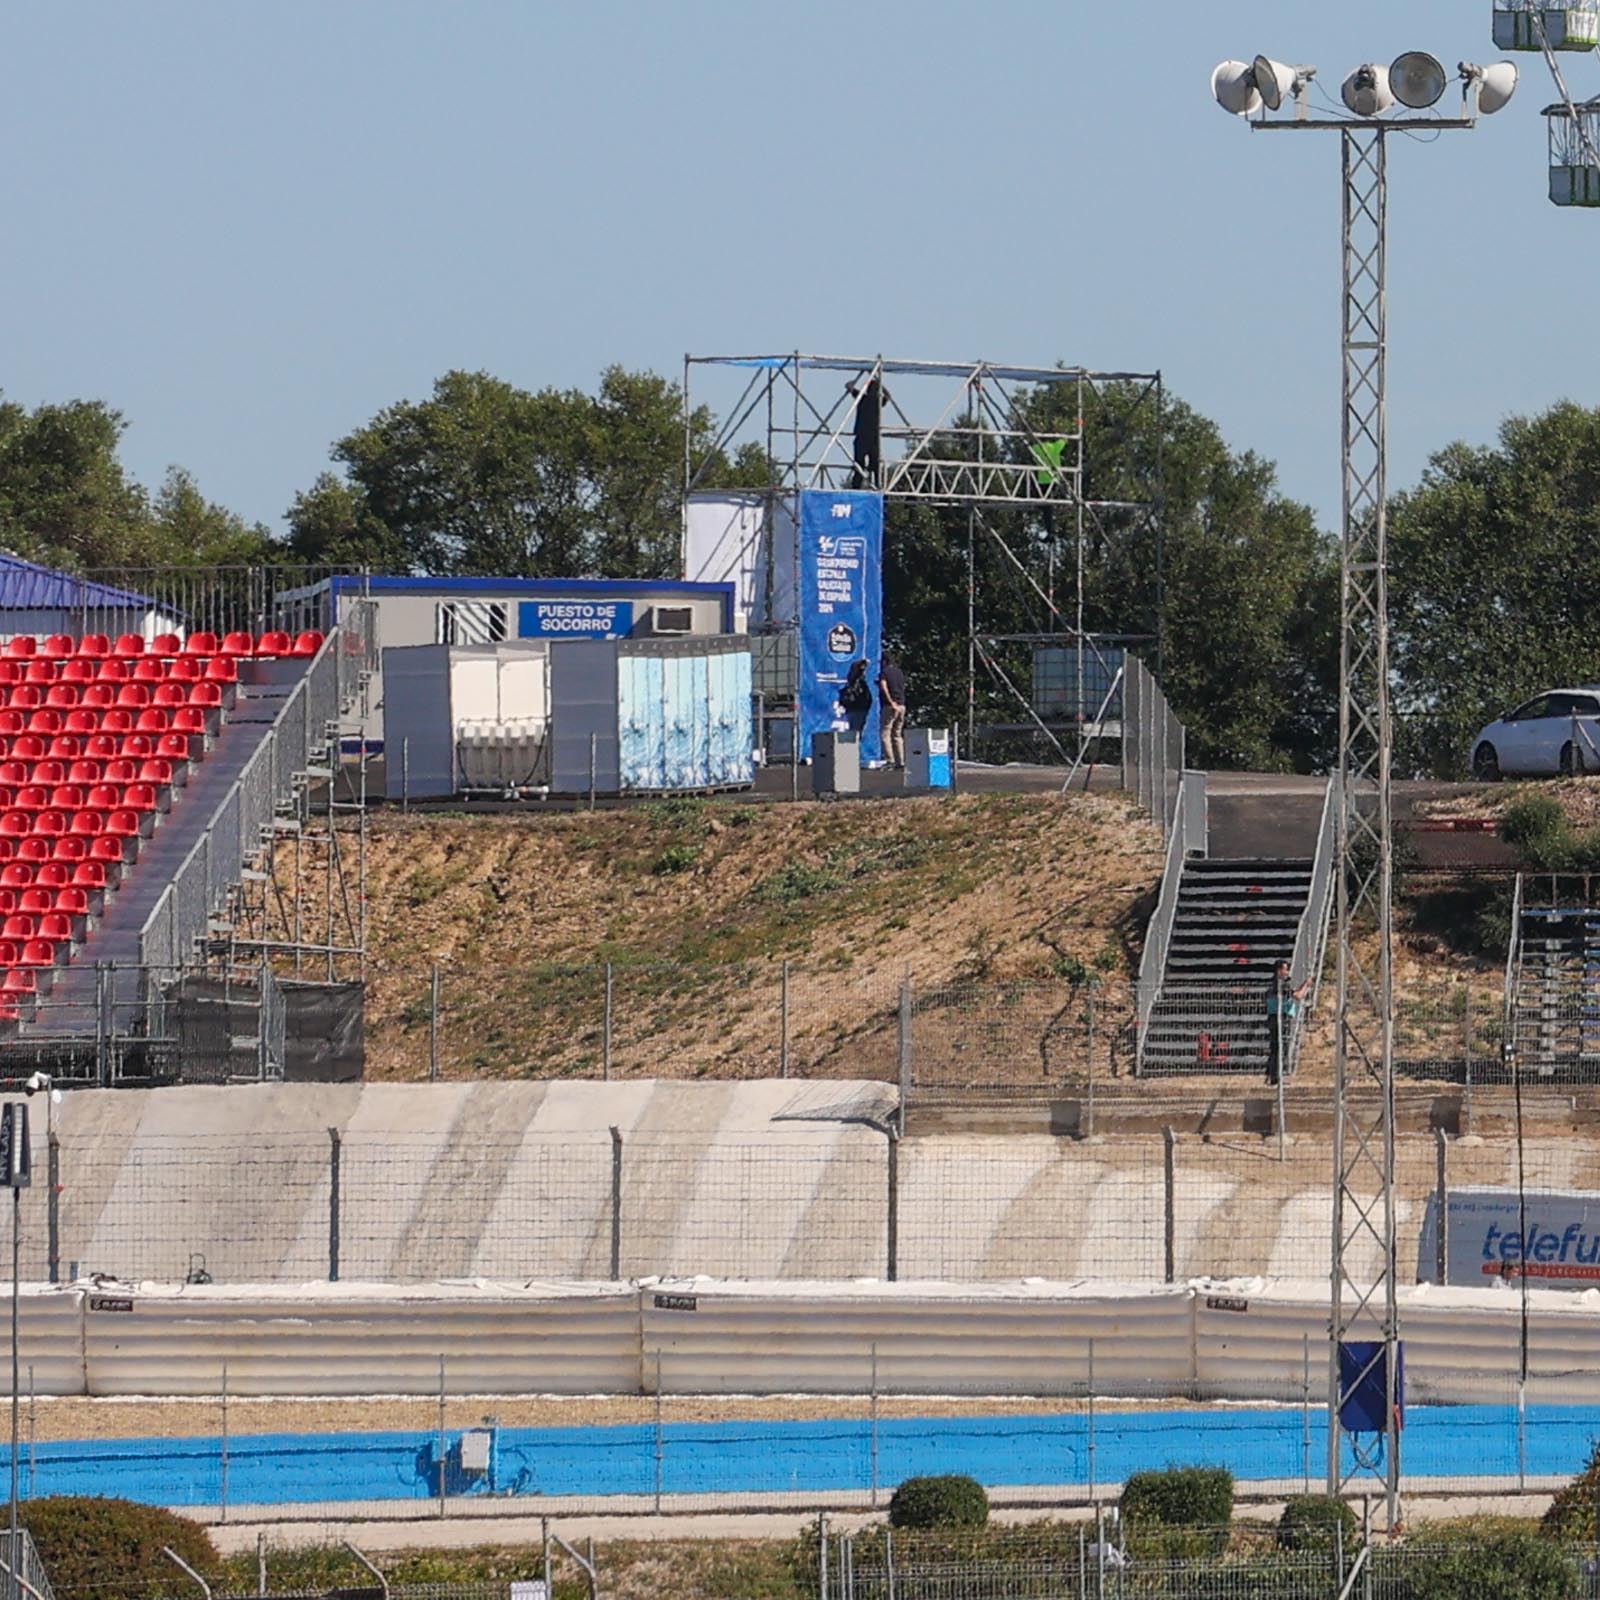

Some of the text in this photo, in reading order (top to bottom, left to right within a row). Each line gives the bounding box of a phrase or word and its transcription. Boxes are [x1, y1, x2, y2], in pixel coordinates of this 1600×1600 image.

[538, 605, 617, 617] PUESTO DE
[541, 618, 612, 630] SOCORRO
